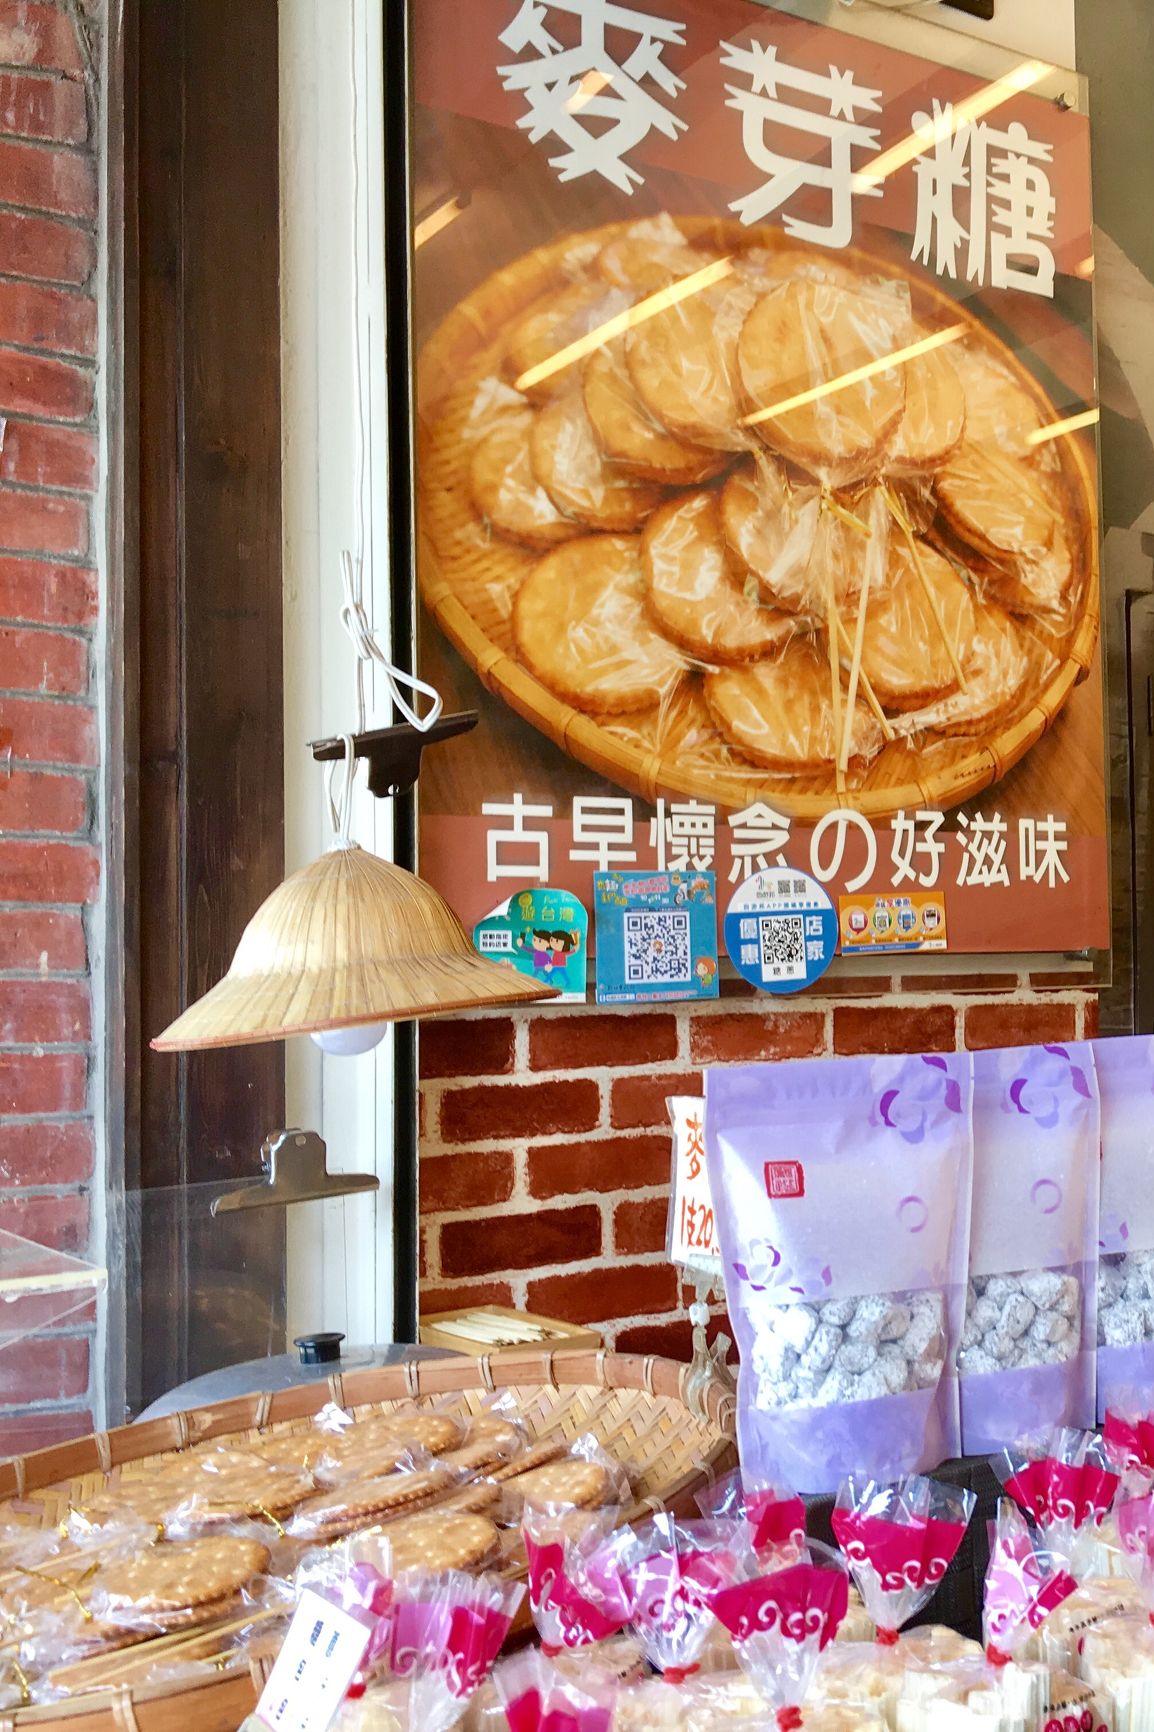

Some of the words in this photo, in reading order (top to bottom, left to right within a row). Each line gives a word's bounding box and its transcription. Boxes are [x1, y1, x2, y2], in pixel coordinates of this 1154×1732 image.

[496, 0, 1054, 298] 麥芽糖
[481, 792, 1071, 894] 古早懷念の好滋味
